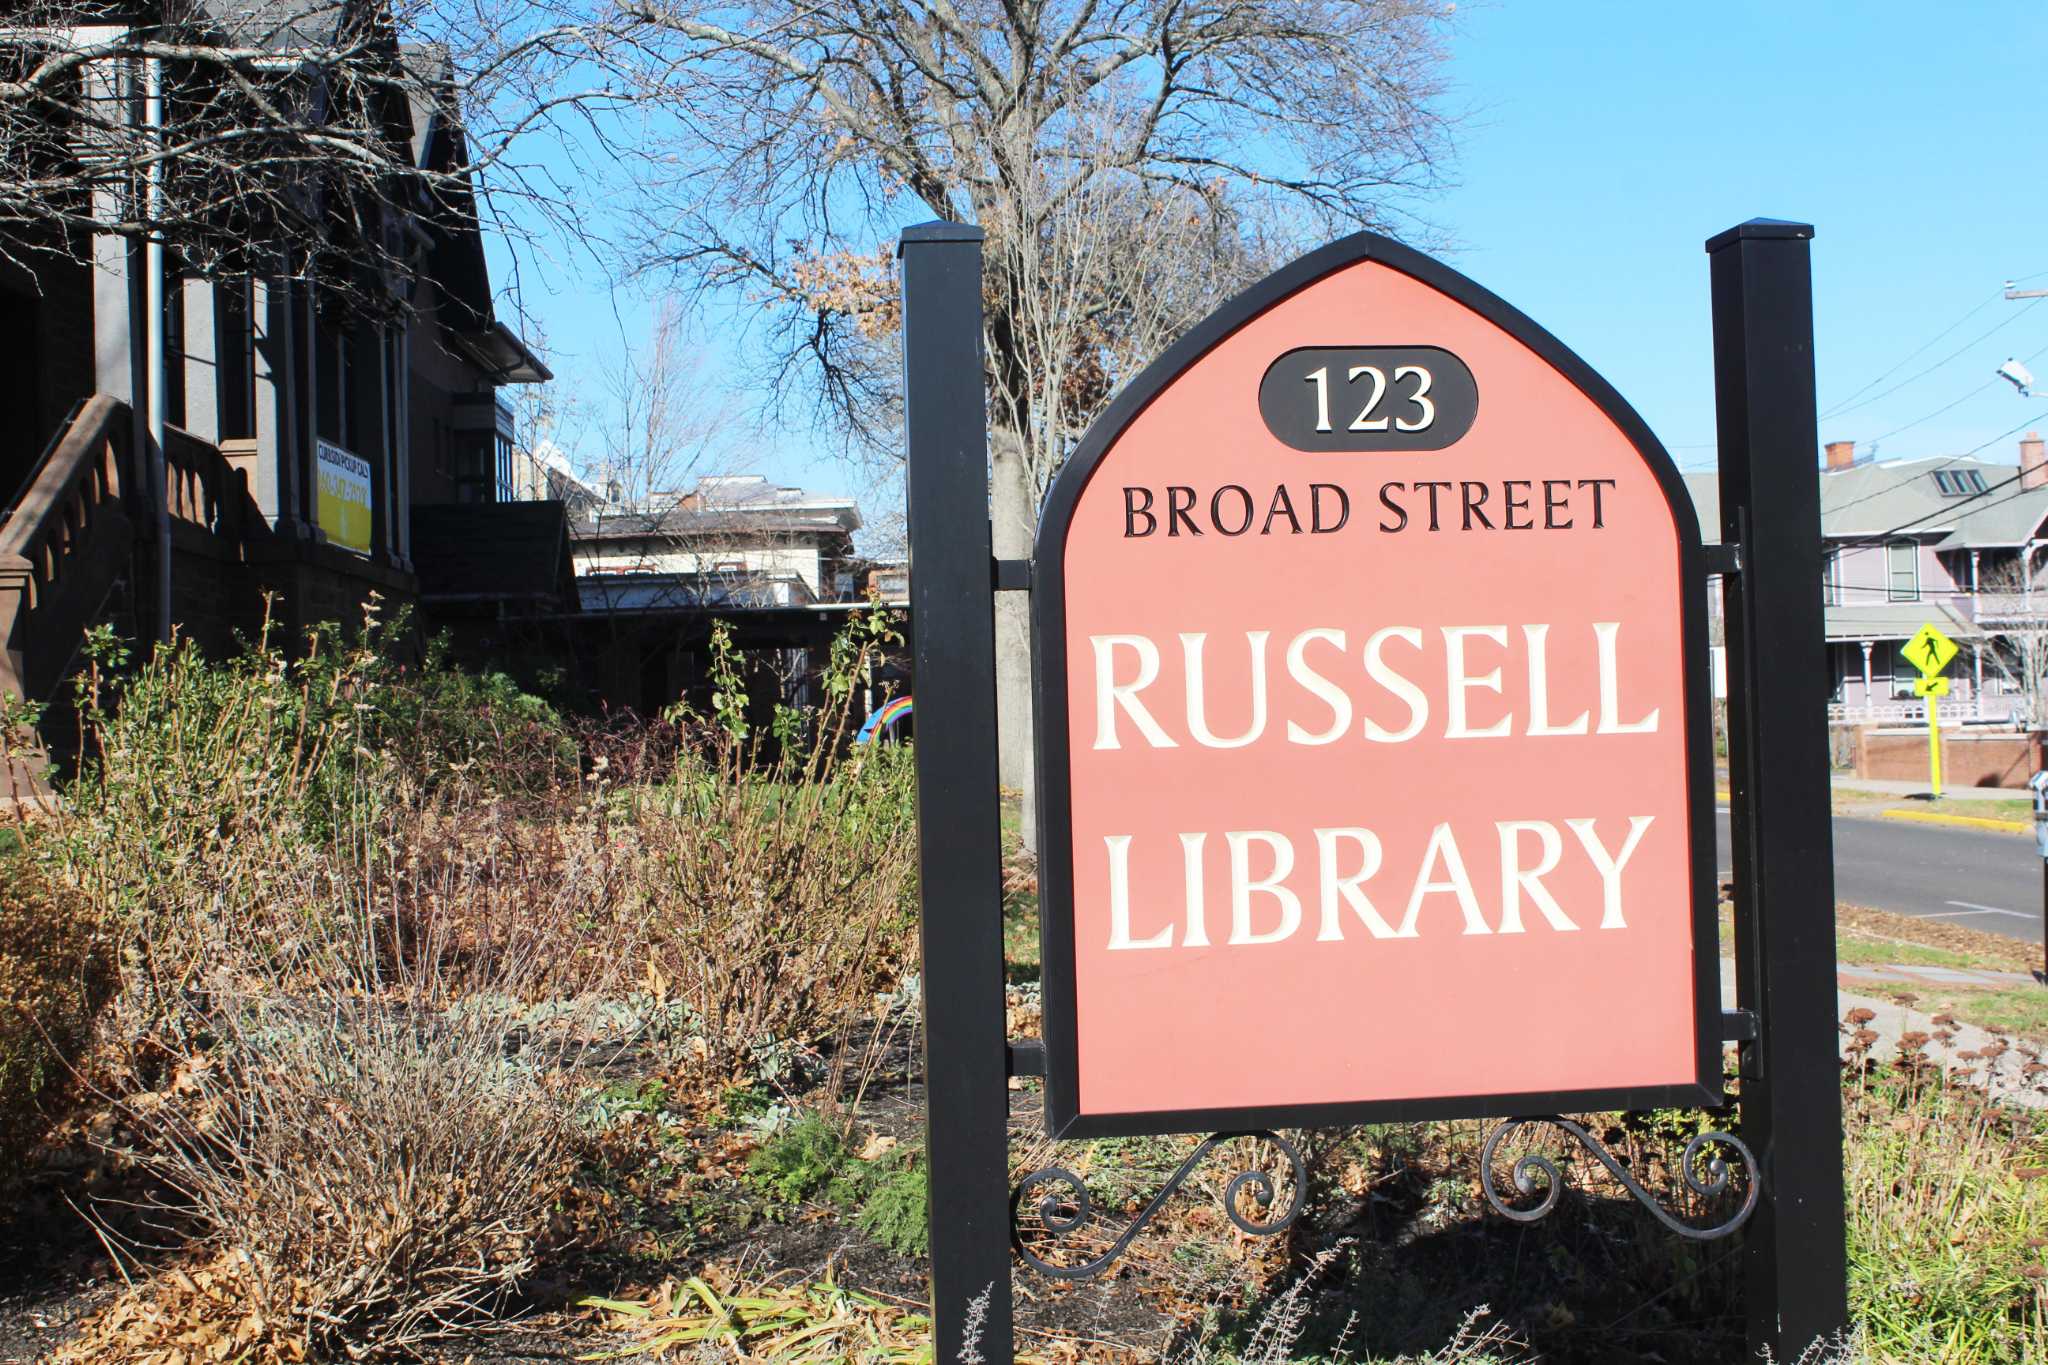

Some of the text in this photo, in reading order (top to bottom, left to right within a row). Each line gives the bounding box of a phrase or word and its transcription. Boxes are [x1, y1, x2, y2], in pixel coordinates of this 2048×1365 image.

[1304, 366, 1435, 431] 123
[1123, 480, 1615, 537] BROAD STREET
[1090, 623, 1659, 749] RUSSELL
[1104, 816, 1655, 950] LIBRARY
